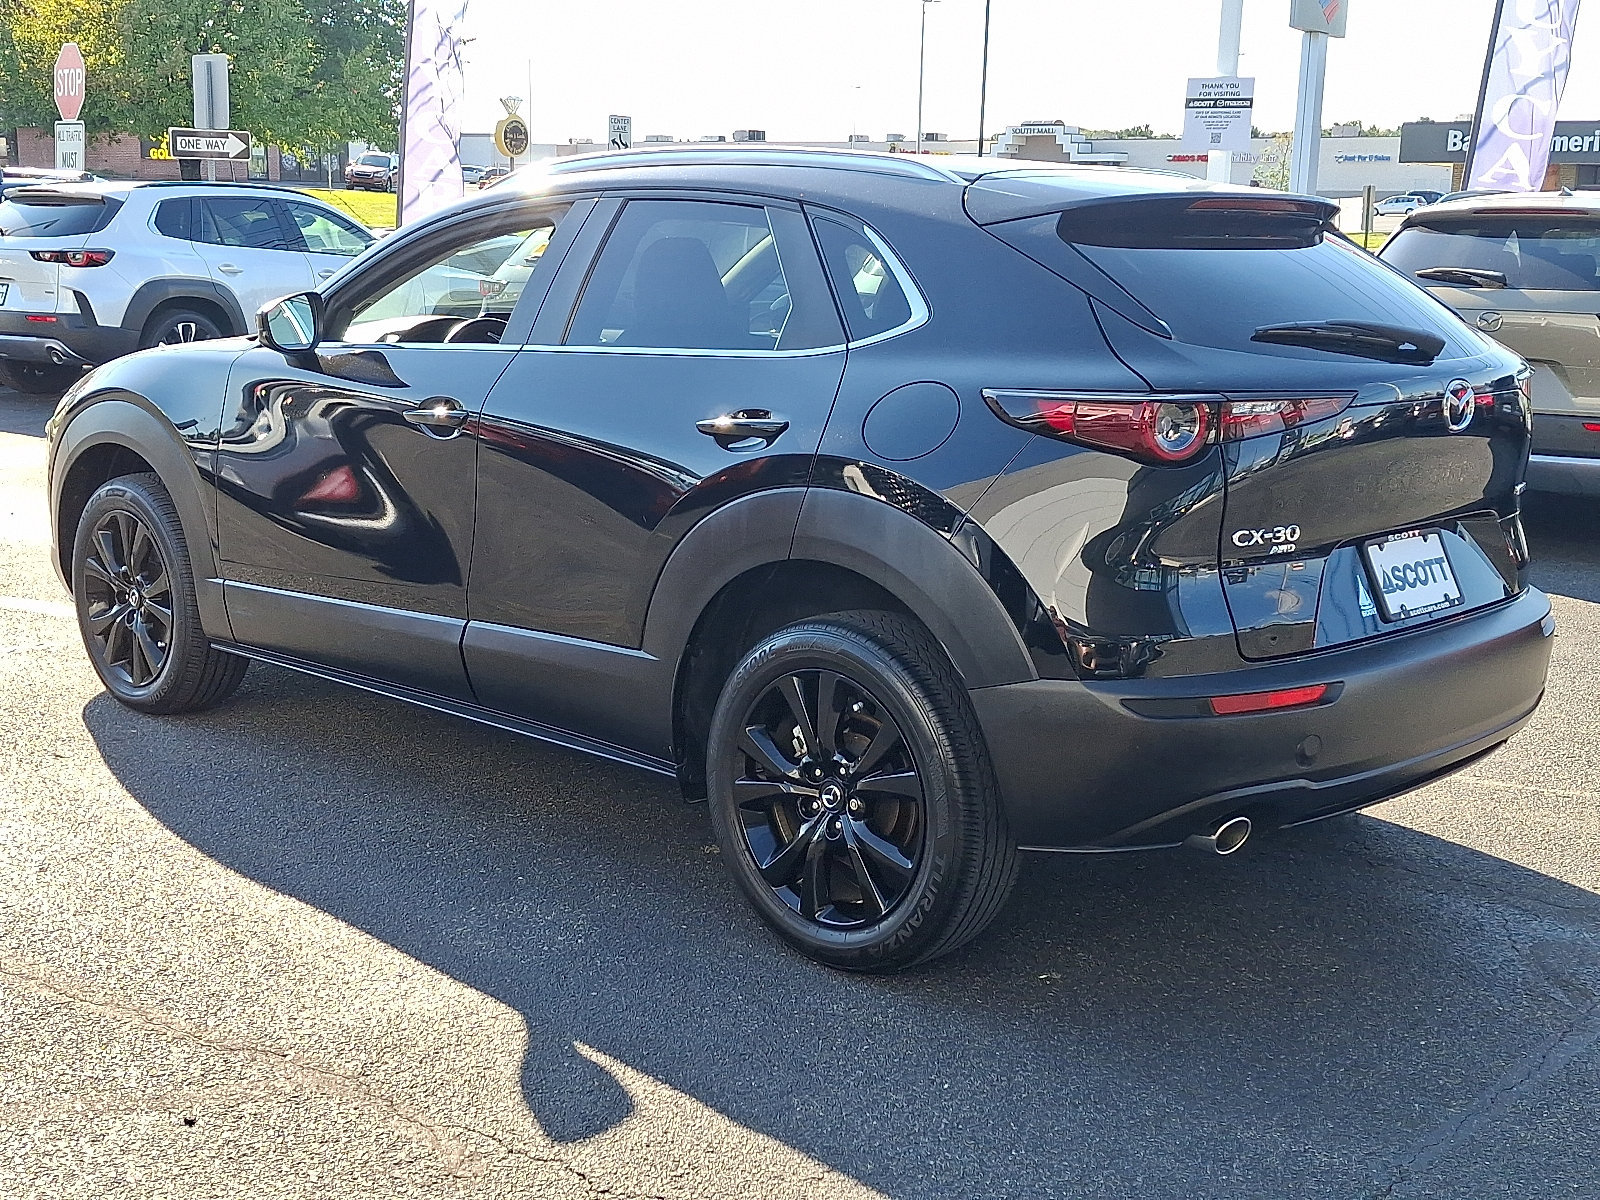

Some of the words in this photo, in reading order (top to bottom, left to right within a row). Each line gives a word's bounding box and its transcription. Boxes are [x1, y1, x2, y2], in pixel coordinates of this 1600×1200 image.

[57, 69, 82, 96] STOP
[66, 131, 81, 141] TRAFFIC
[1447, 130, 1470, 151] Ba
[1551, 130, 1600, 151] meri
[180, 139, 201, 149] ONE
[205, 140, 227, 150] WAY
[62, 152, 77, 168] MUST
[149, 148, 172, 159] GOL
[1232, 525, 1301, 547] CX-30
[1388, 530, 1420, 541] SCOTT
[1269, 543, 1296, 554] AWD
[1391, 556, 1448, 591] SCOTT
[1410, 602, 1450, 616] scottcars.com
